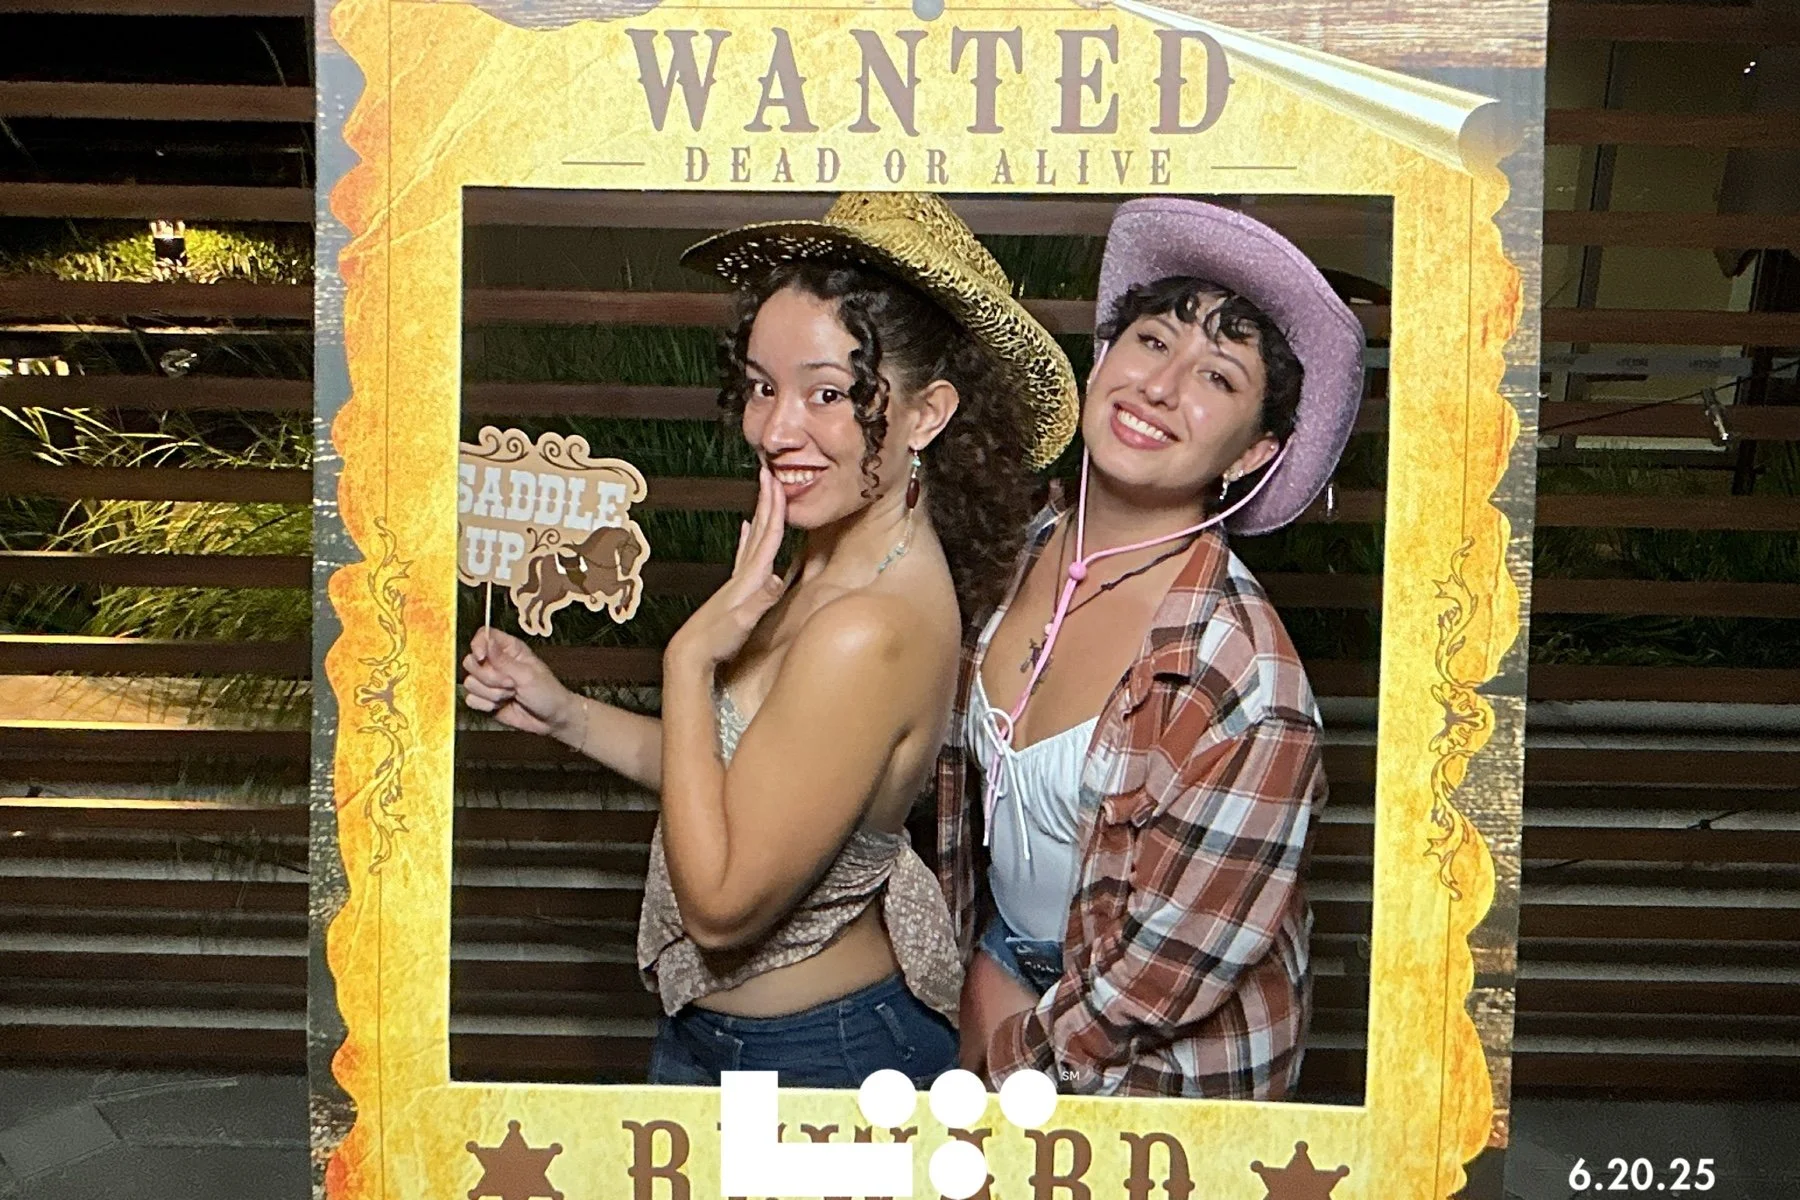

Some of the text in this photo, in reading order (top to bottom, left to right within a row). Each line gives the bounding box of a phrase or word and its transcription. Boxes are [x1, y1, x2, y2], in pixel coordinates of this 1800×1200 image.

[624, 24, 1235, 137] WANTED
[685, 146, 1171, 186] DEAD OR ALIVE
[458, 463, 627, 530] SADDLE
[466, 526, 525, 580] UP
